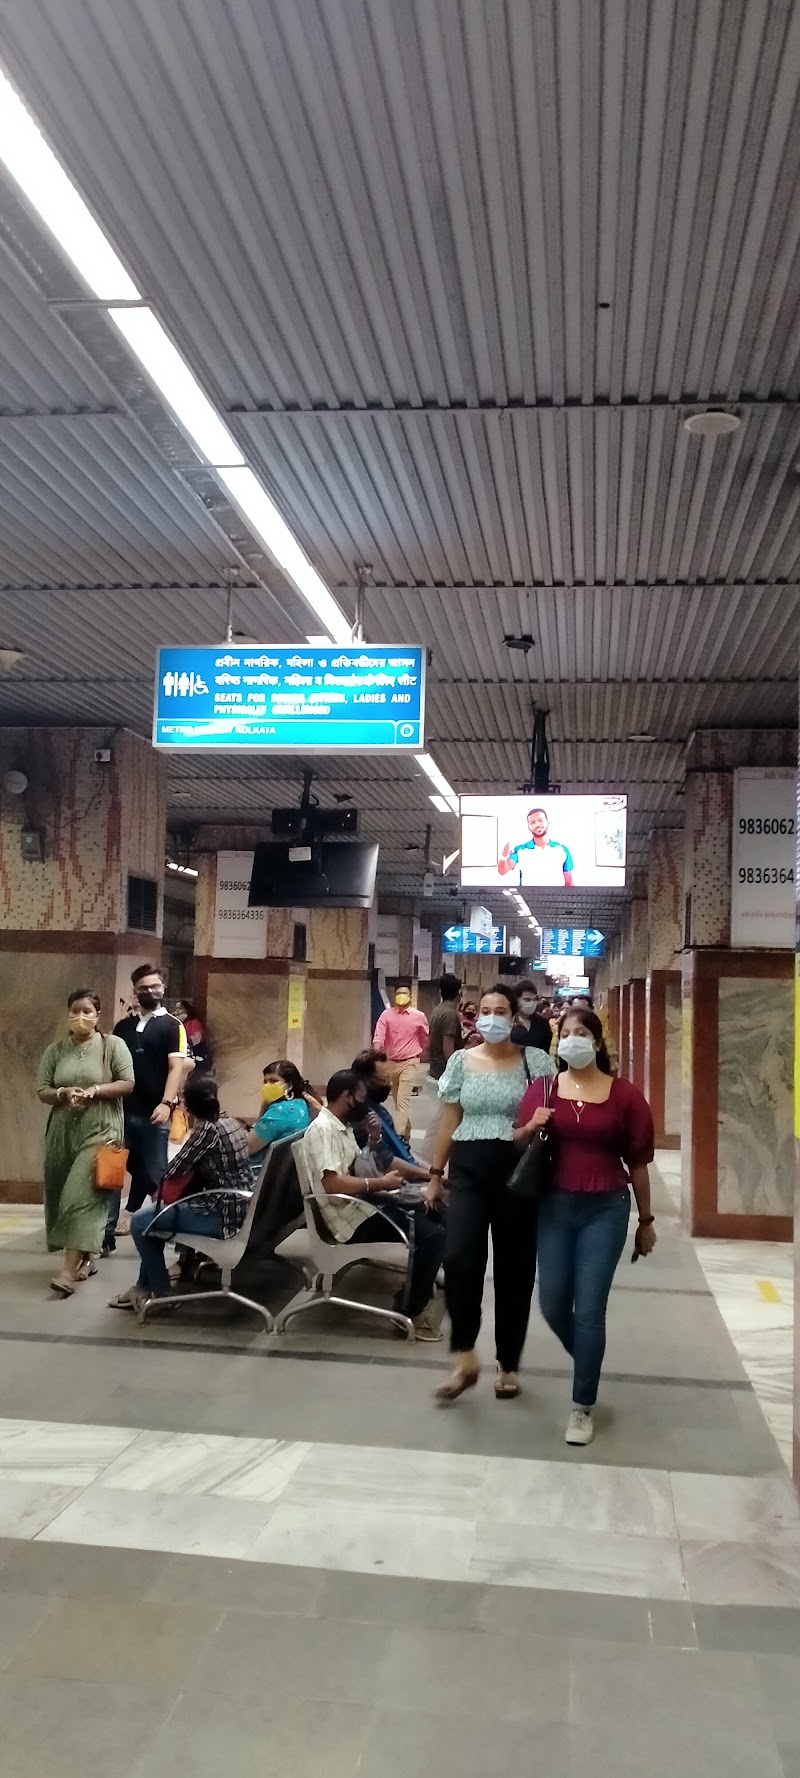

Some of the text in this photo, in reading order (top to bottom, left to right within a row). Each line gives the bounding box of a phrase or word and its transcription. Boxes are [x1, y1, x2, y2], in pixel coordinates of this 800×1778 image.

[214, 693, 242, 702] SEATS
[247, 693, 265, 702] FOR
[353, 693, 386, 703] LADIES
[391, 693, 410, 703] AND
[739, 818, 797, 835] 9836062
[218, 909, 264, 921] 9836364336
